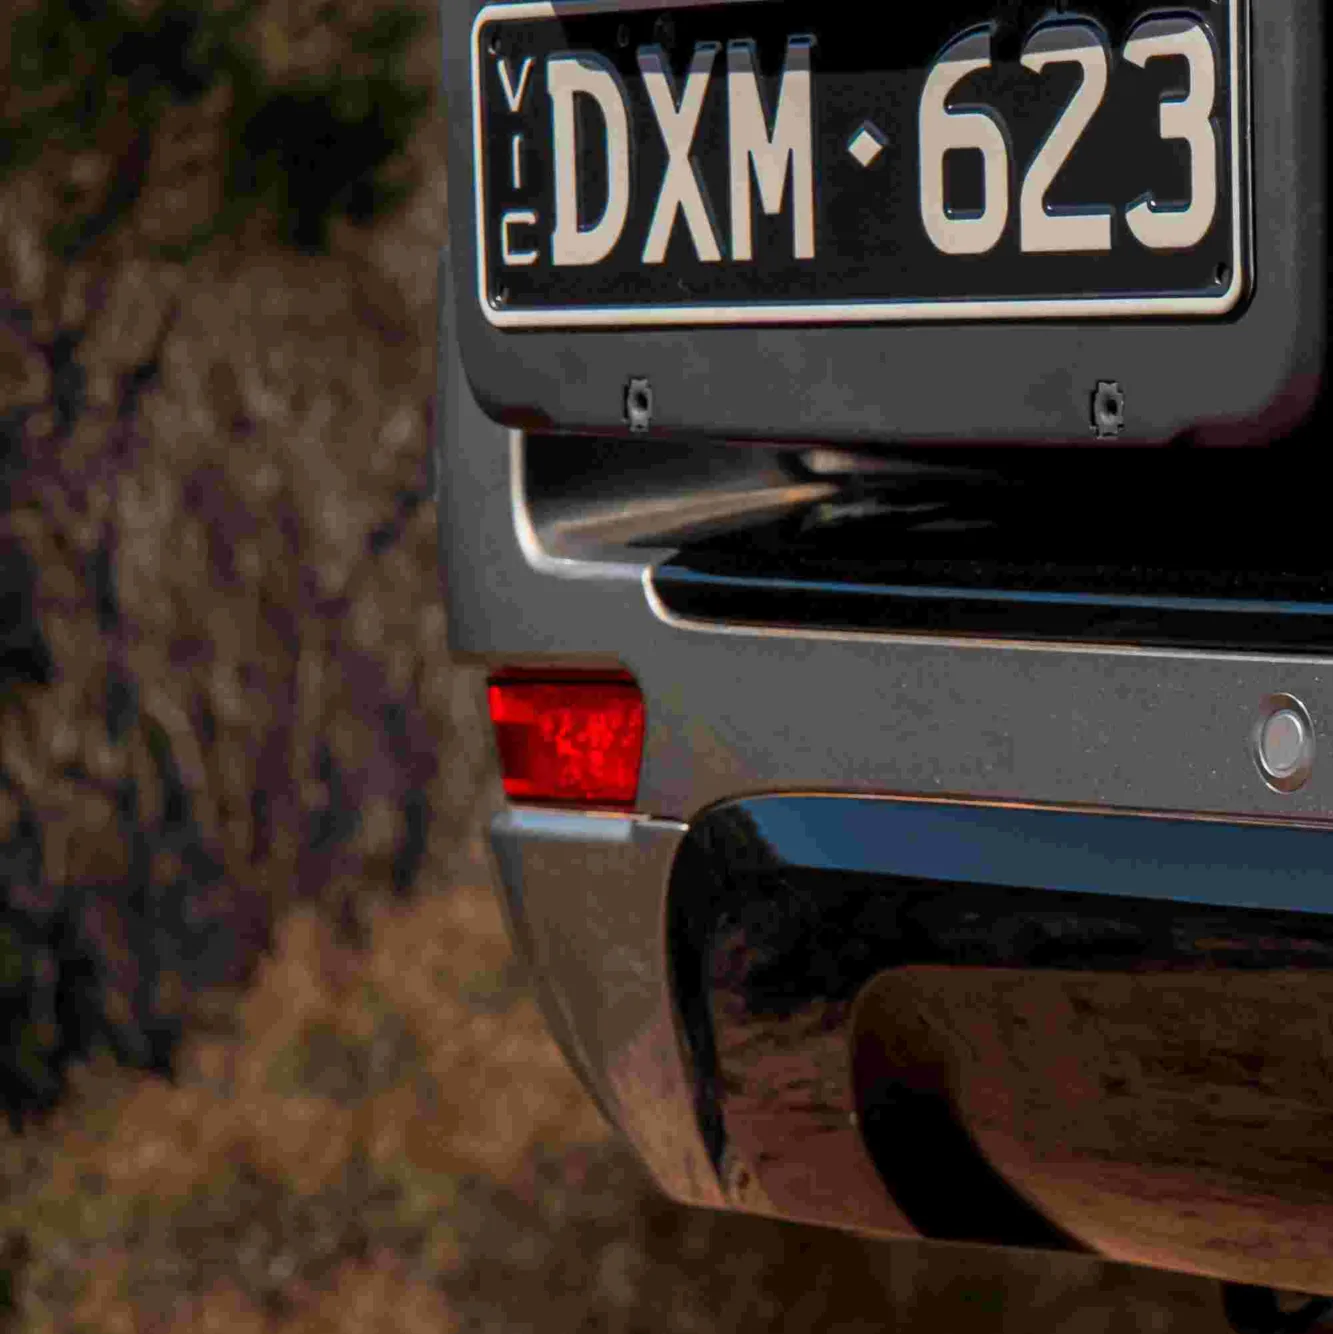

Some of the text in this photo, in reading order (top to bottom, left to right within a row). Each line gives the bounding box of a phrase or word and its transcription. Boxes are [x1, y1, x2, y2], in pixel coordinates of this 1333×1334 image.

[497, 58, 538, 265] VIC
[546, 12, 1217, 267] DXM 623
